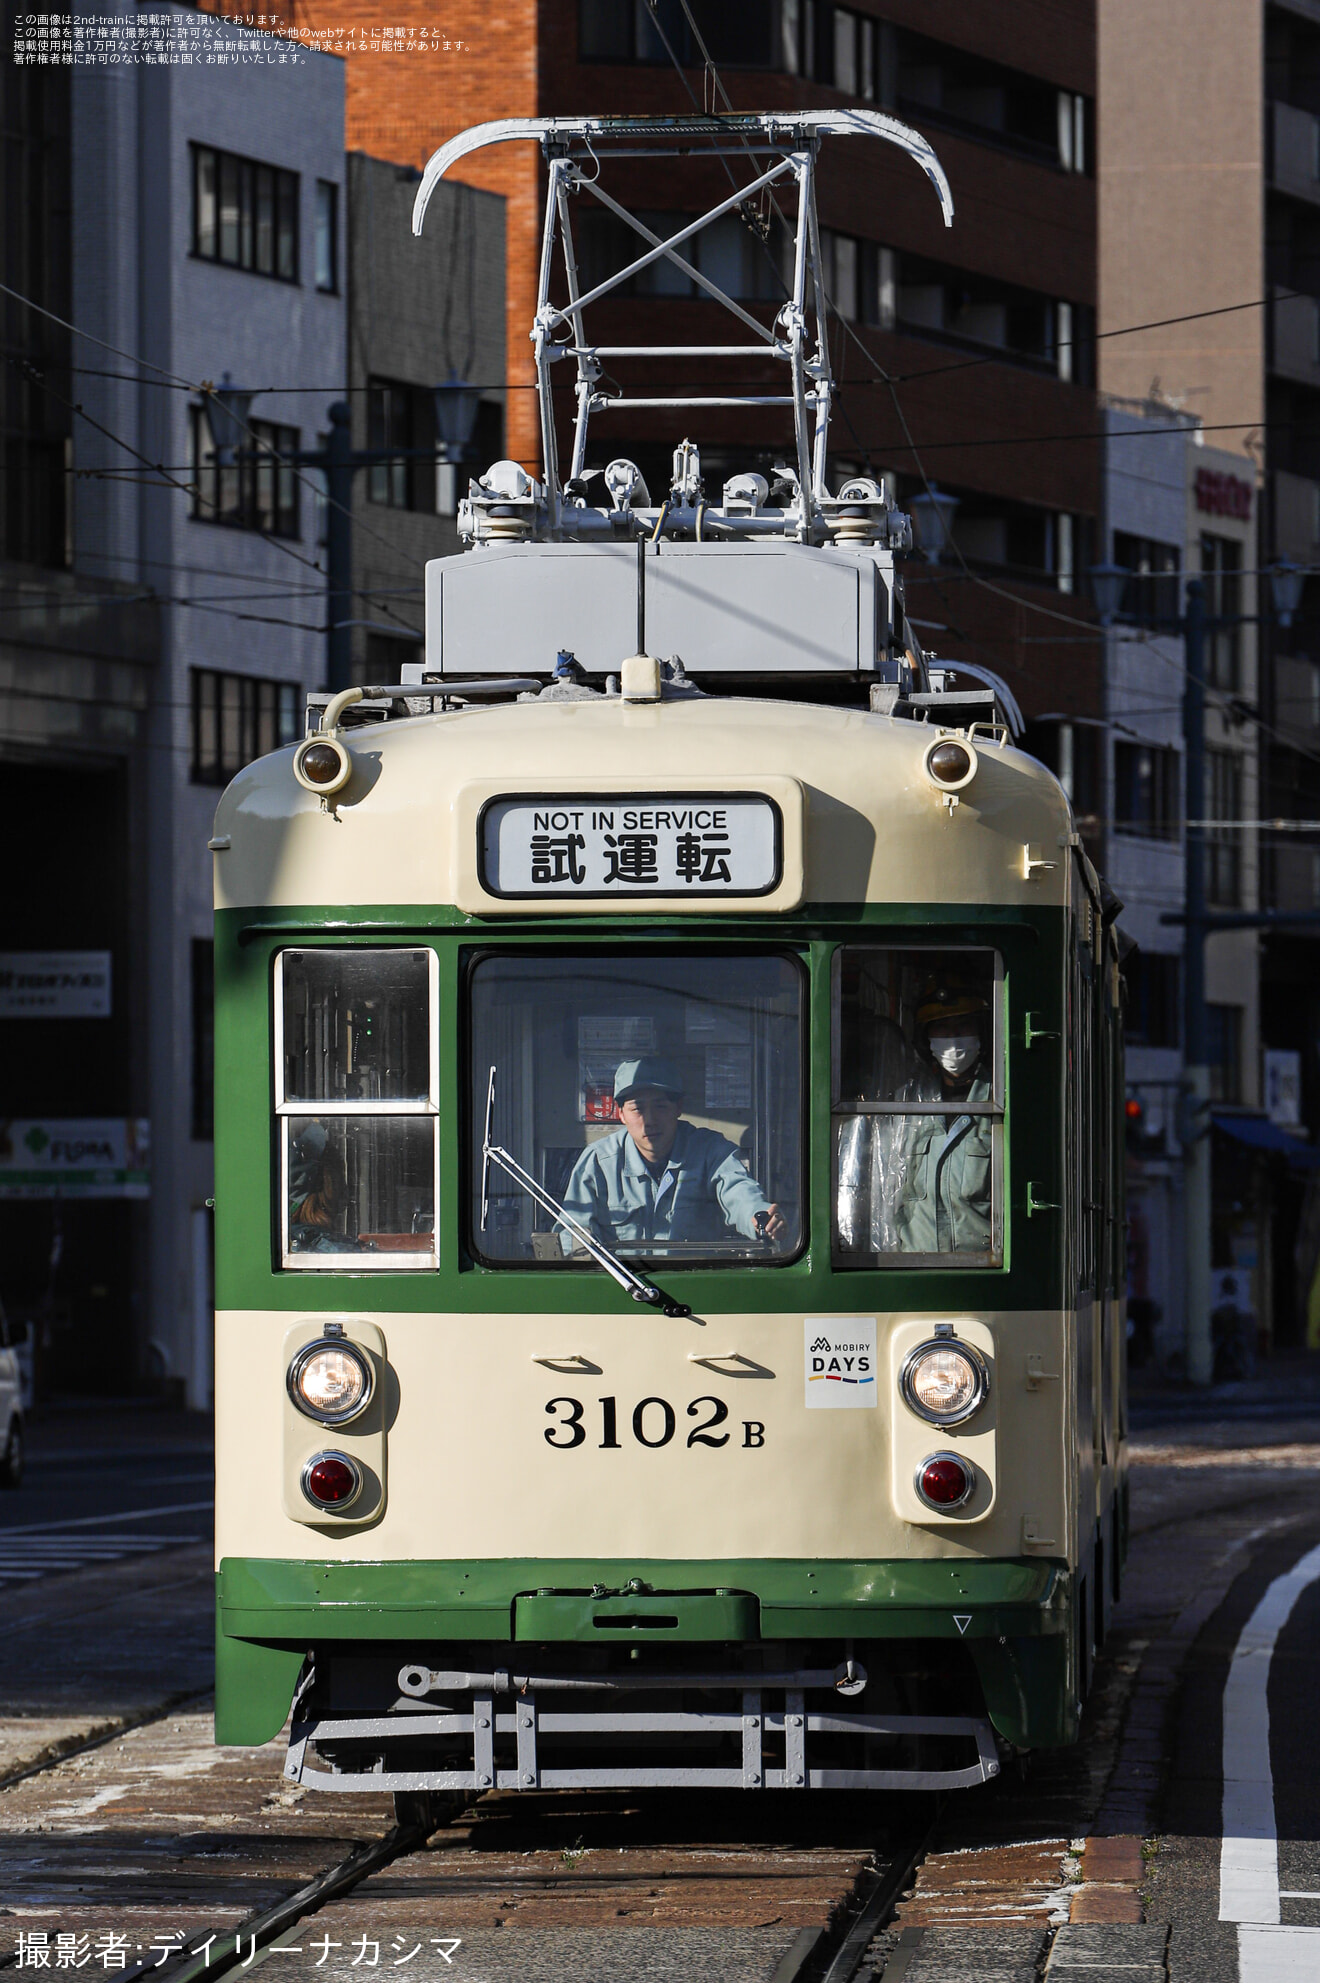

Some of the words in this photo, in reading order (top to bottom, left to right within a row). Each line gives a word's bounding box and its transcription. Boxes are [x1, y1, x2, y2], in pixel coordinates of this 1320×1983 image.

[534, 812, 584, 831] NOT
[592, 811, 614, 830] IN
[623, 810, 727, 830] SERVICE
[530, 832, 732, 885] 試運転
[834, 1343, 871, 1352] MOBIRY
[812, 1356, 871, 1372] DAYS
